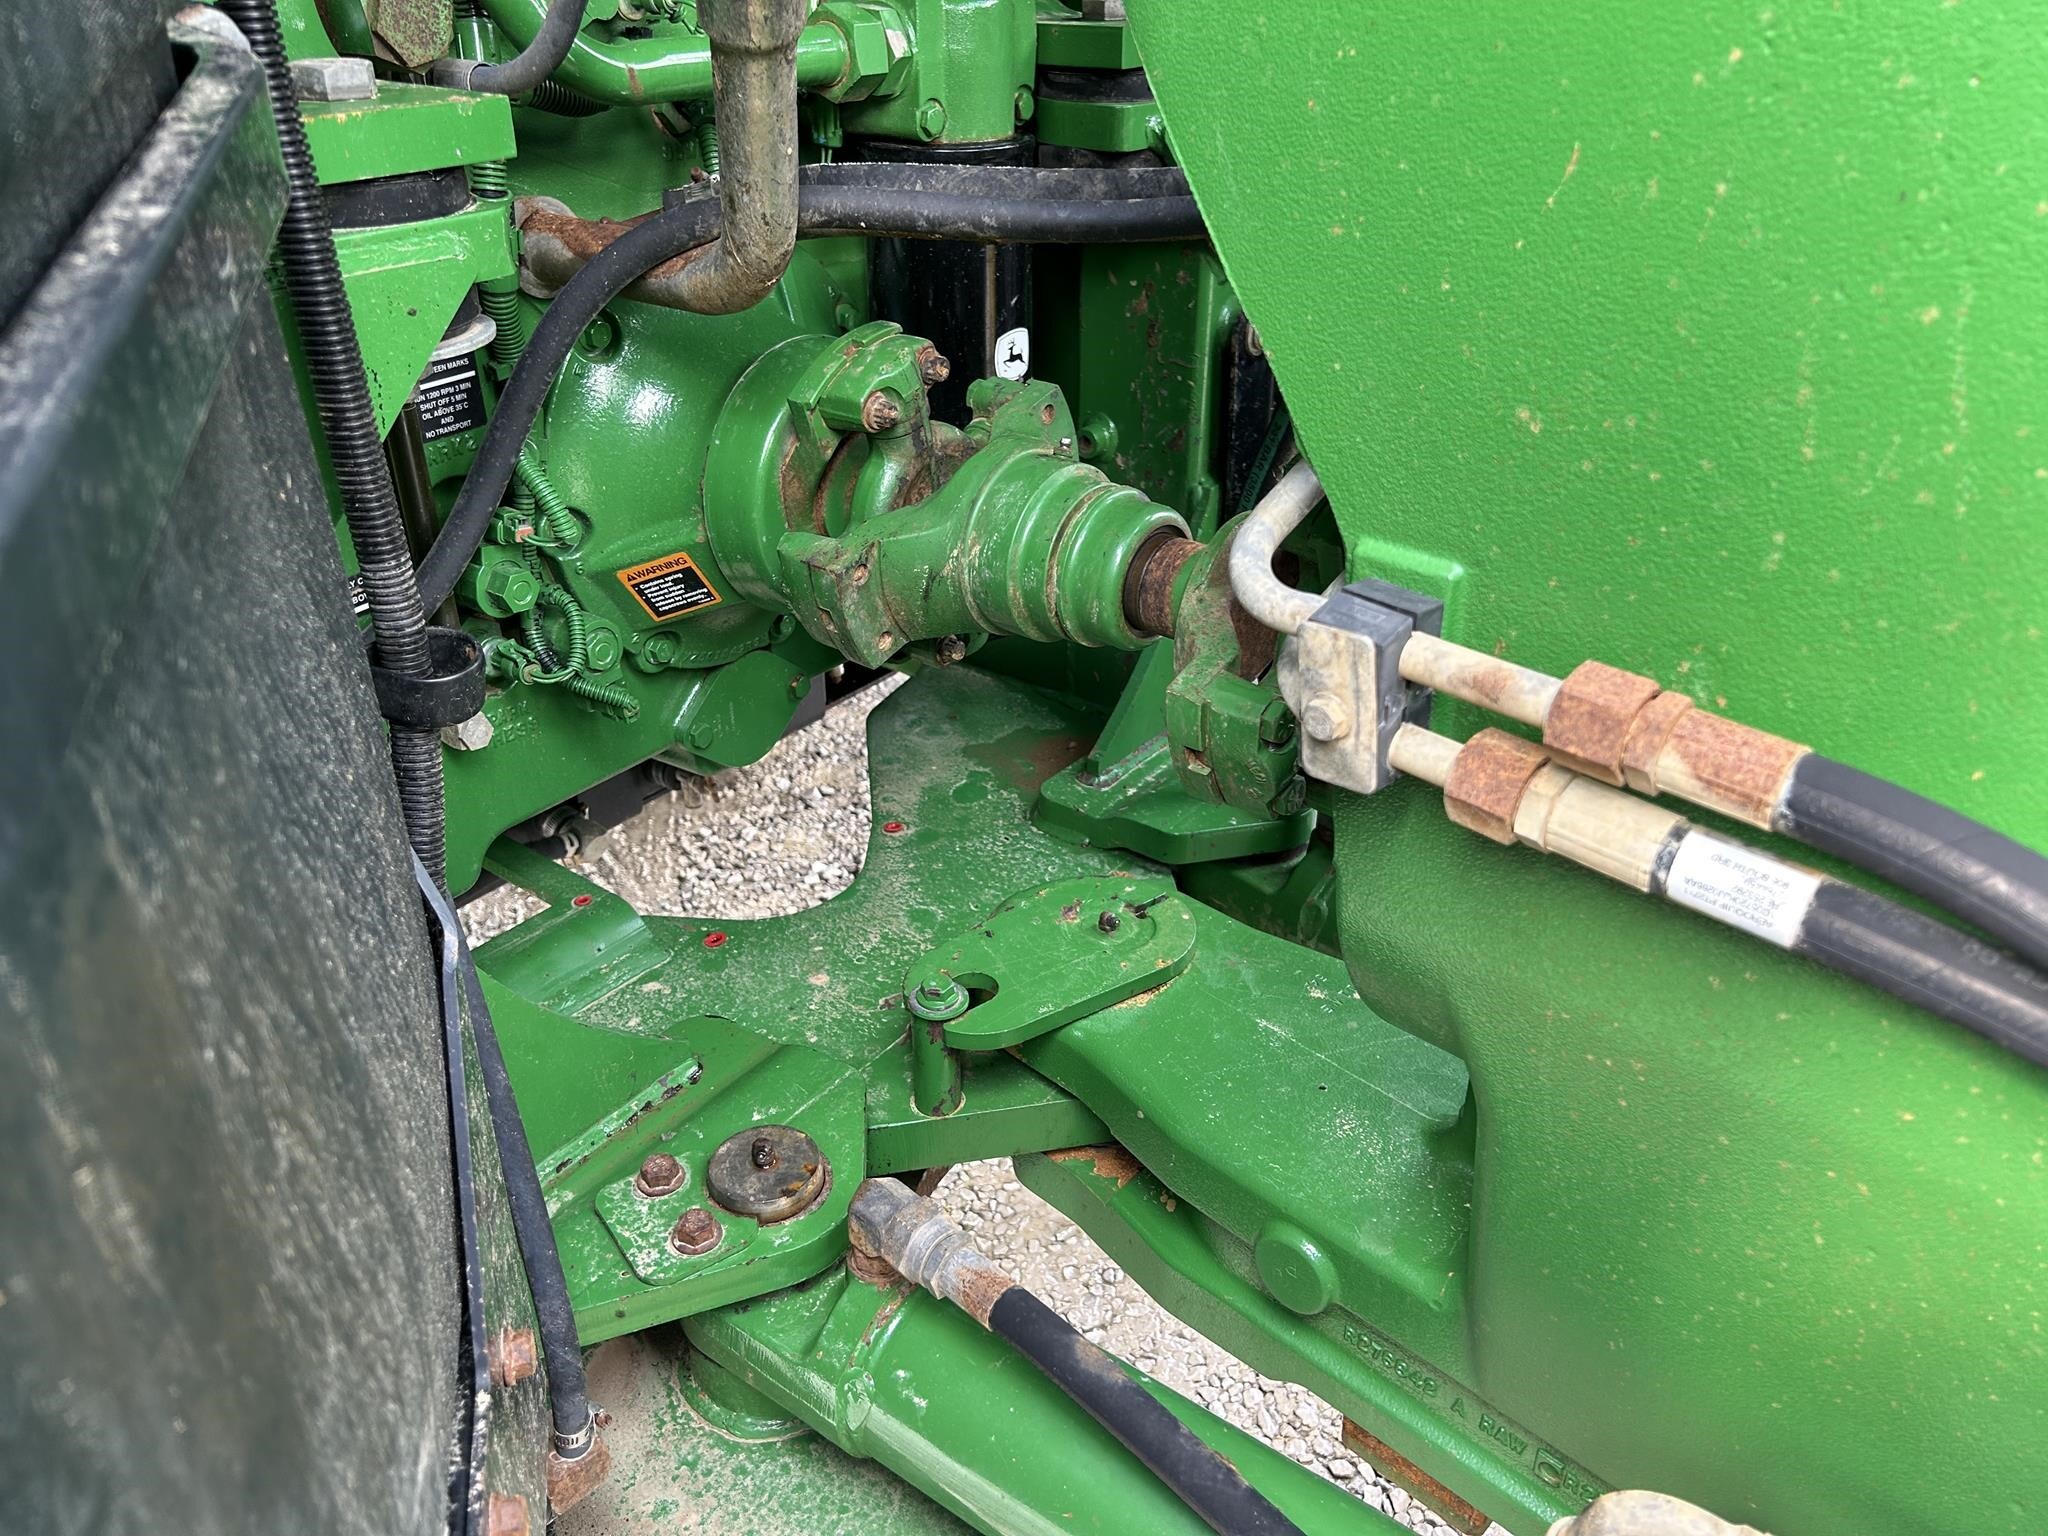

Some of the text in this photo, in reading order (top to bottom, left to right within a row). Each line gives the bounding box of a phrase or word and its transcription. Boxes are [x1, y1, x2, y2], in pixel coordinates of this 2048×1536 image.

[447, 358, 470, 370] MARKS
[426, 390, 440, 400] 1200
[440, 387, 455, 396] RPM
[460, 381, 472, 389] MIN
[420, 400, 437, 411] SHUT
[437, 397, 450, 406] OFF
[456, 392, 467, 401] MIN
[422, 411, 433, 420] OIL
[433, 404, 455, 416] ABOVE
[441, 415, 455, 425] AND
[425, 420, 472, 439] NO TRANSPORT
[633, 557, 688, 580] WARNING
[1478, 1412, 1529, 1457] RAW
